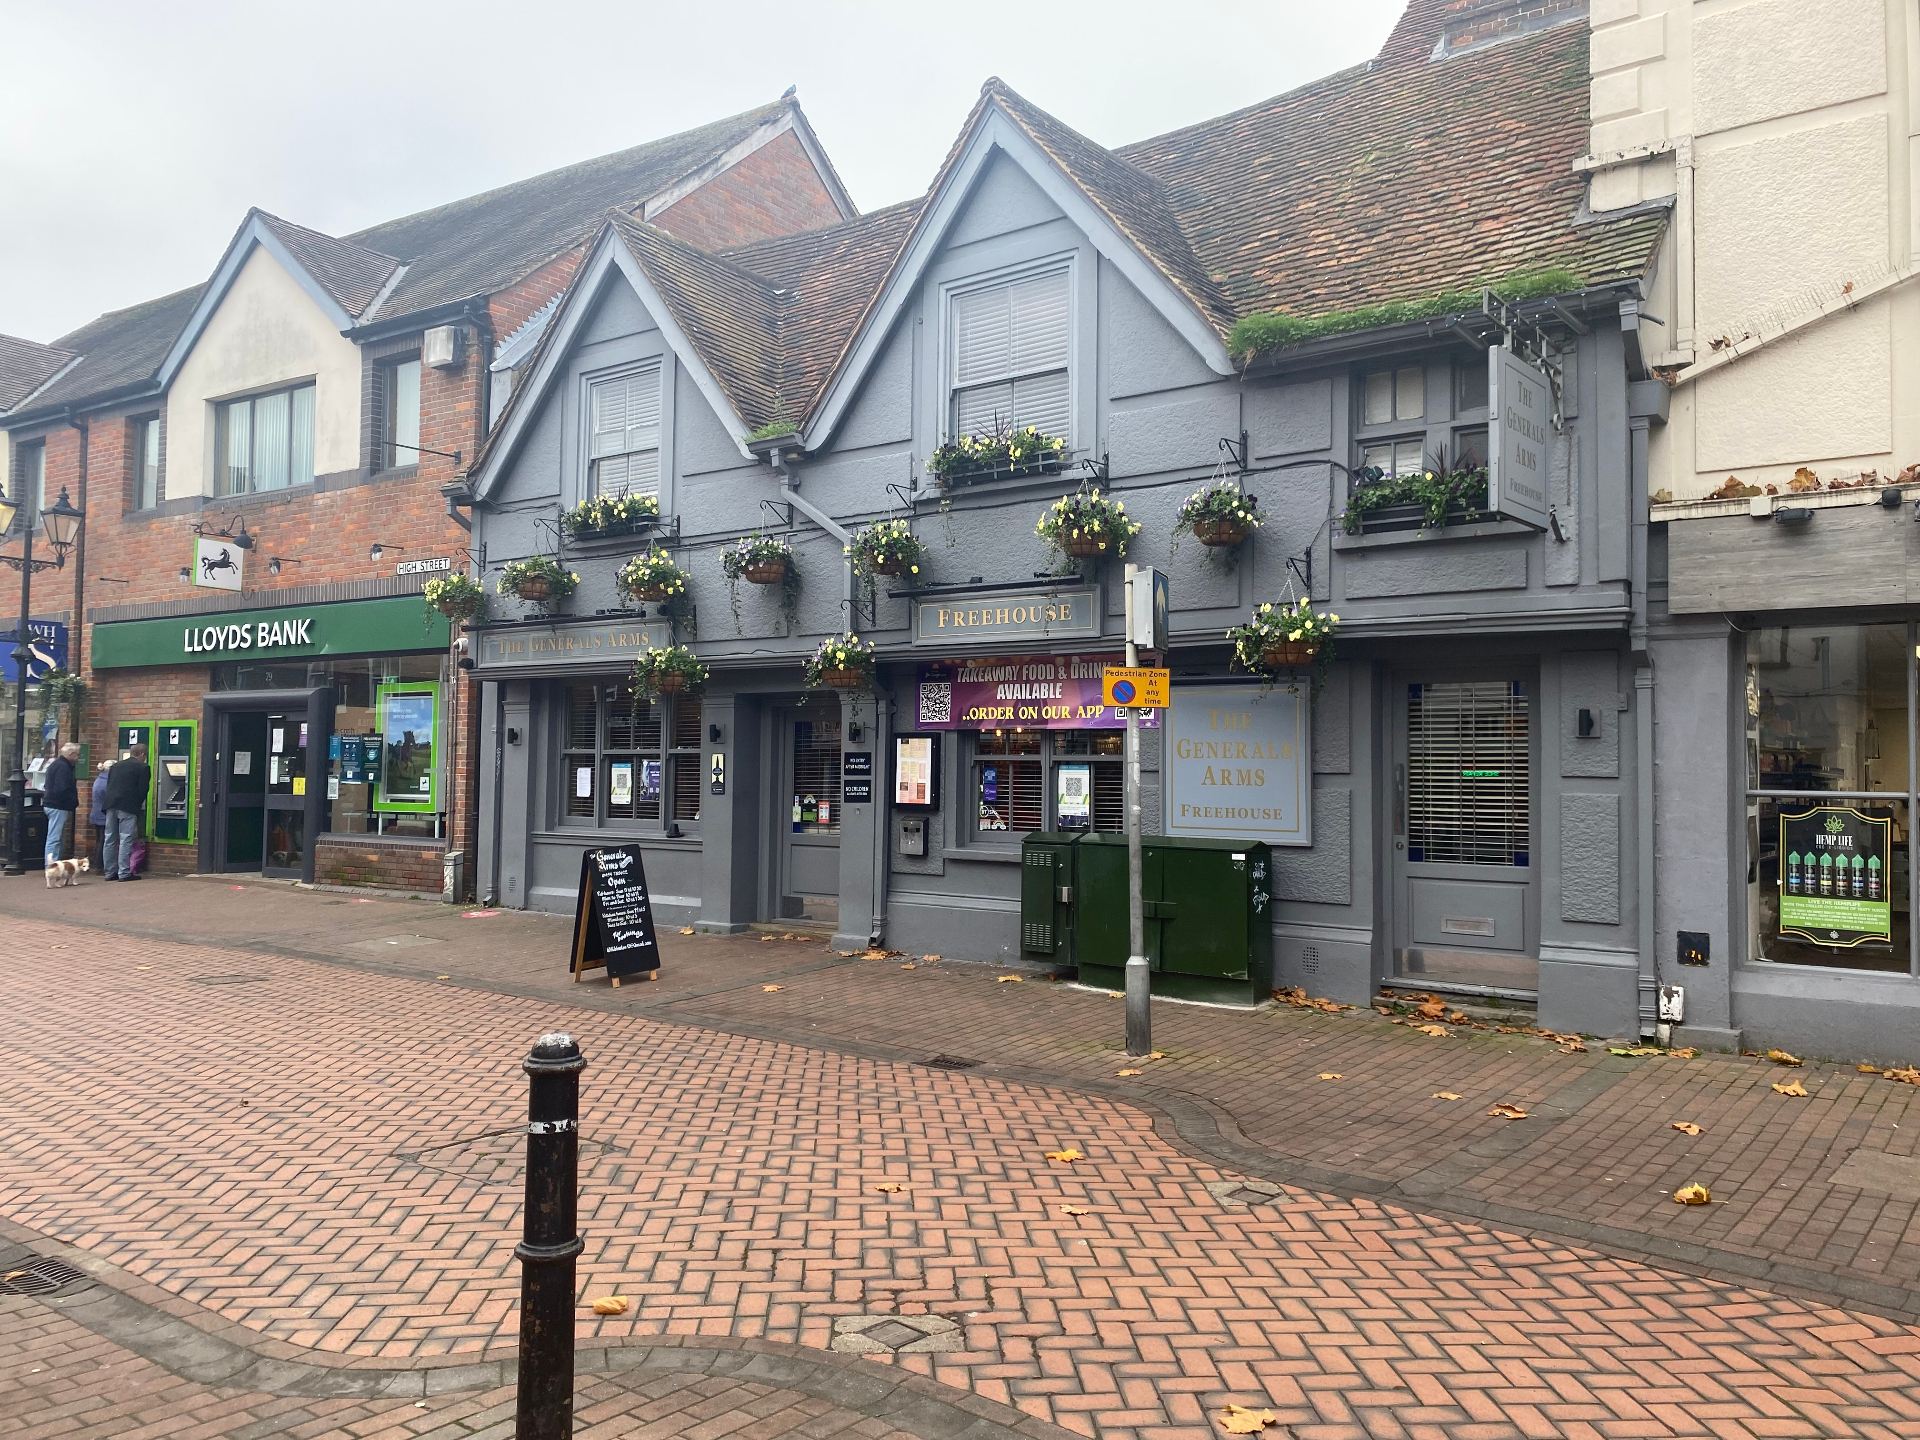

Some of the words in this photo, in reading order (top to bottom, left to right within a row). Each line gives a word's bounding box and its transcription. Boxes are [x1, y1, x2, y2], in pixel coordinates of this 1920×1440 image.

[1518, 380, 1532, 408] THE
[1507, 406, 1544, 446] GENERALS
[1516, 442, 1536, 472] ARMS
[1510, 478, 1542, 503] FREEHOUSE
[398, 562, 417, 573] HIGH
[420, 558, 448, 571] STREET
[938, 604, 1072, 628] FREEHOUSE
[184, 624, 252, 652] LLOYDS
[258, 618, 312, 648] BANK
[500, 639, 524, 654] THE
[530, 636, 601, 652] GENERALS
[607, 632, 649, 648] ARMS
[957, 665, 1019, 682] TAKEAWAY
[1022, 664, 1057, 681] FOOD
[1059, 666, 1067, 679] &
[997, 683, 1062, 700] AVAILABLE
[1021, 706, 1039, 719] ON
[1042, 706, 1070, 719] OUR
[1076, 705, 1104, 719] APP
[1207, 709, 1253, 730] THE
[1176, 738, 1293, 760] GENERALS
[1202, 766, 1265, 786] ARMS
[1180, 804, 1283, 820] FREEHOUSE
[1816, 834, 1836, 846] HEMP
[1838, 836, 1853, 847] LIFE
[599, 861, 618, 870] Arms
[608, 877, 626, 888] Open
